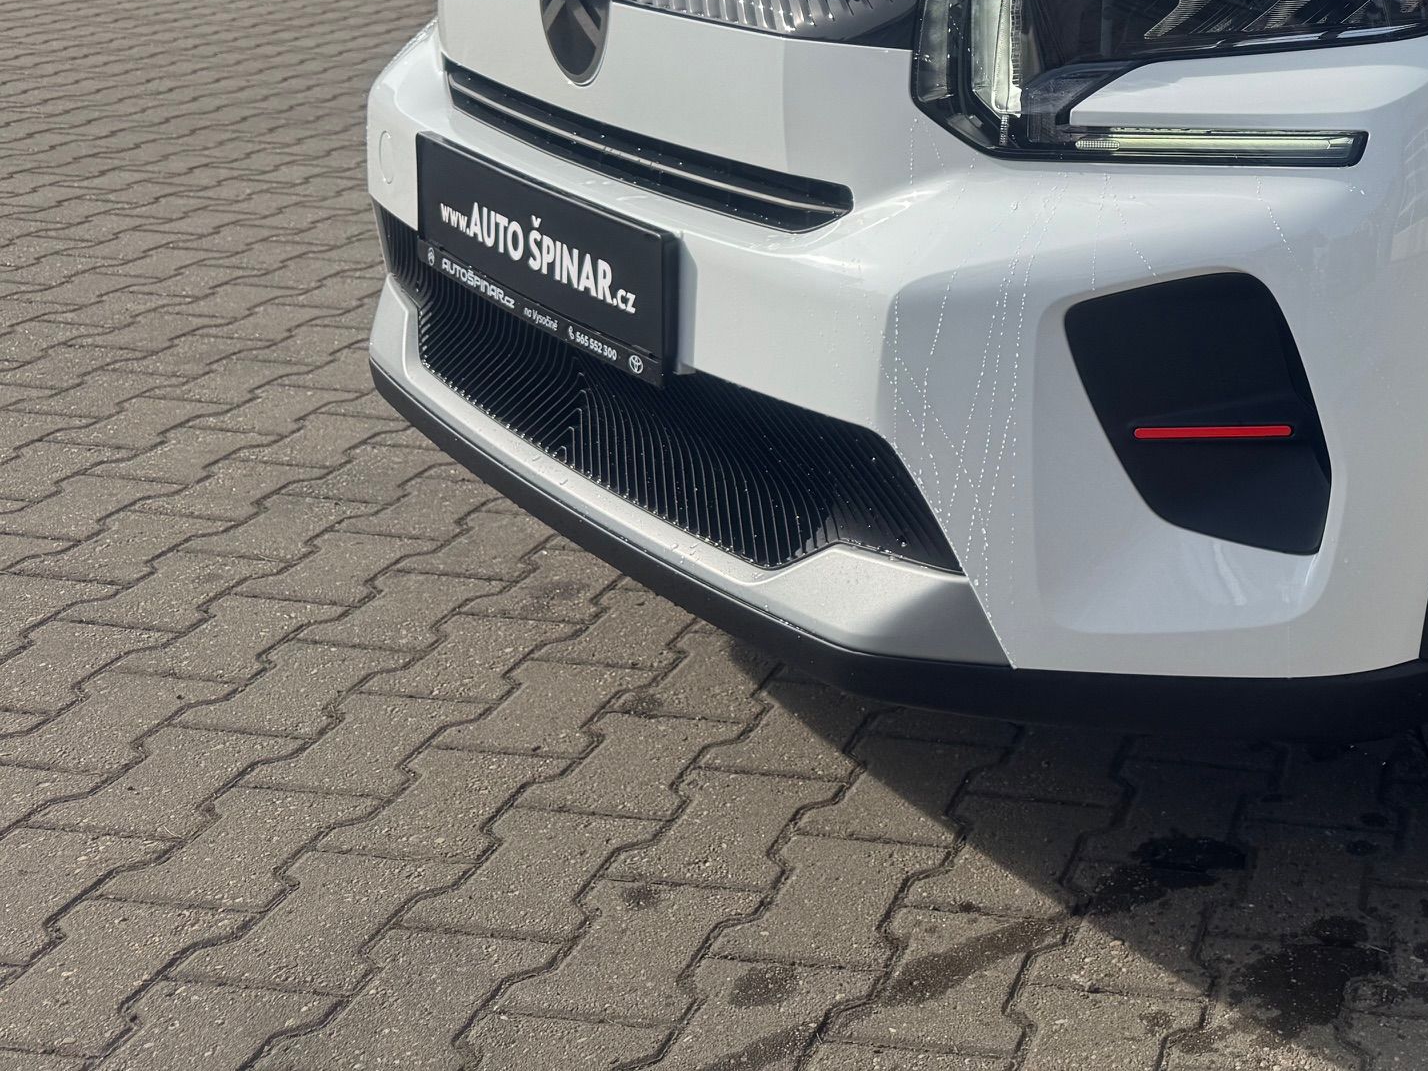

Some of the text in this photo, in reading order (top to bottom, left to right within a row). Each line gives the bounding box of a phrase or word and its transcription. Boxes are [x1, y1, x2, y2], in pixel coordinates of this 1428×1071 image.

[440, 201, 524, 261] www.AUTO
[576, 331, 617, 361] 565 552 300
